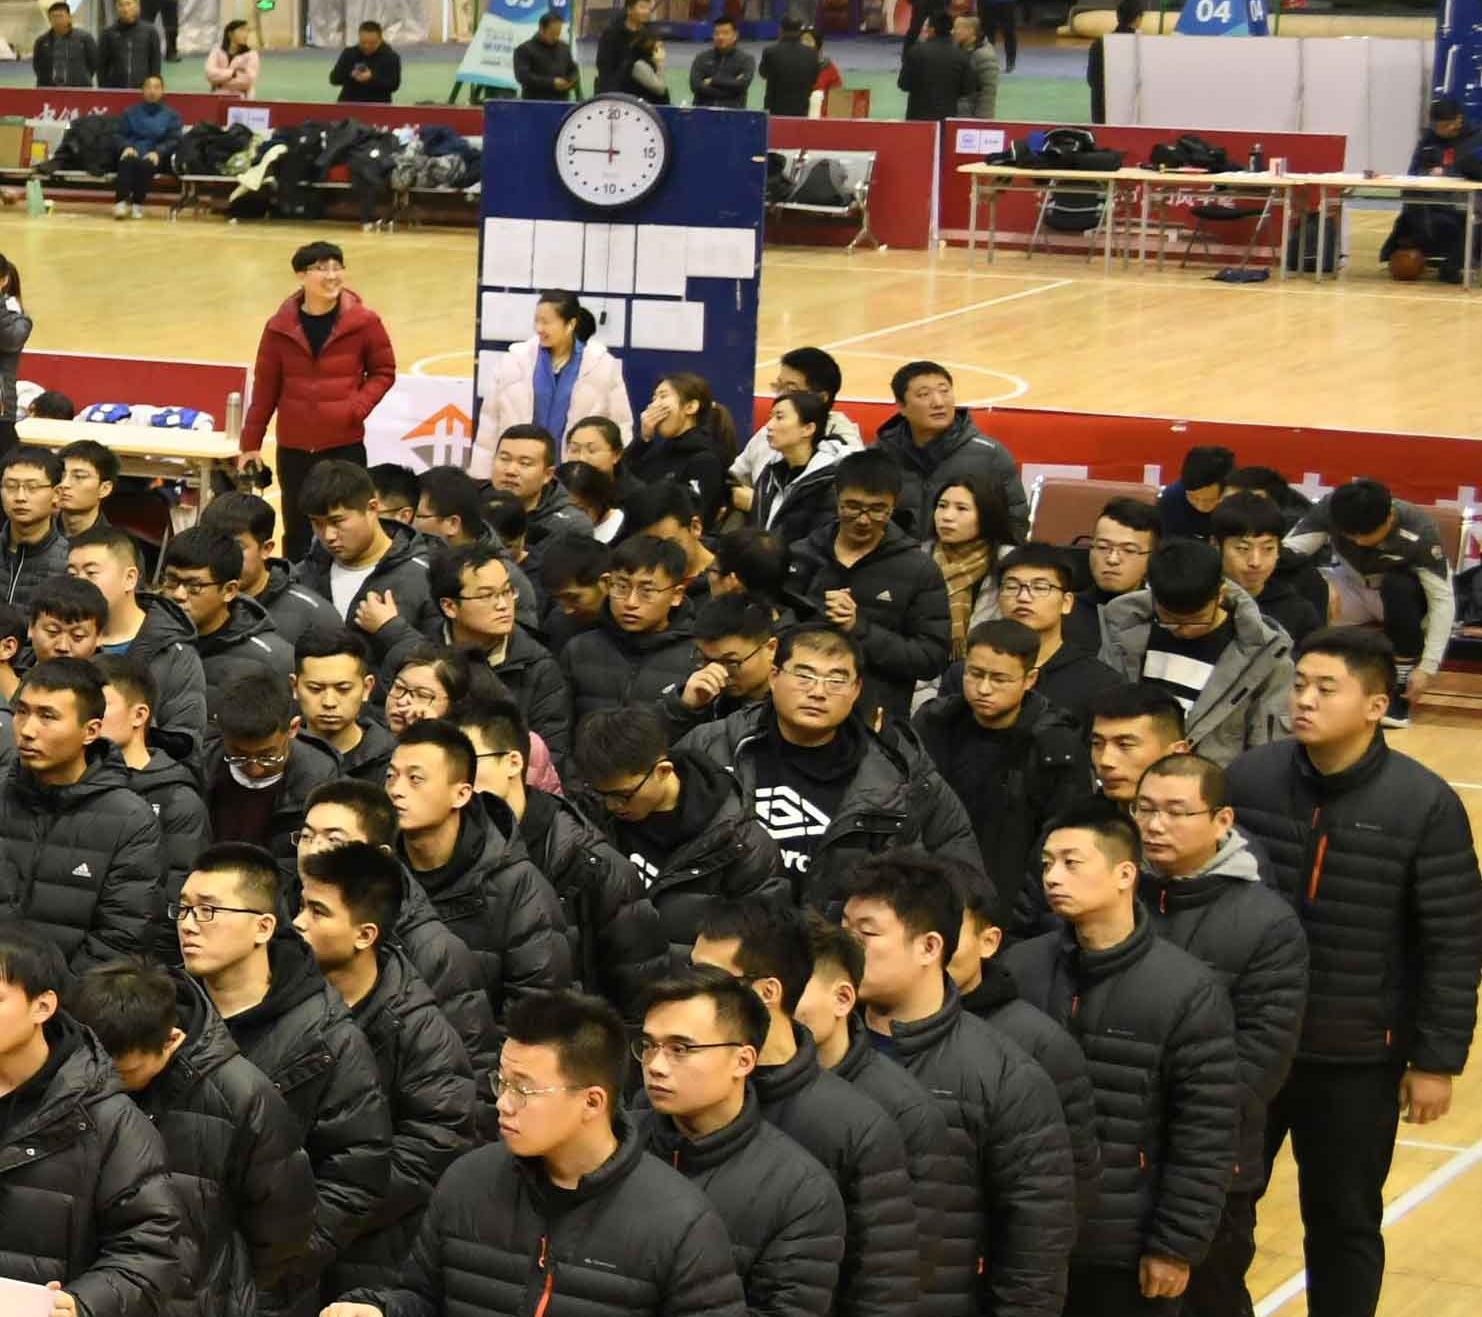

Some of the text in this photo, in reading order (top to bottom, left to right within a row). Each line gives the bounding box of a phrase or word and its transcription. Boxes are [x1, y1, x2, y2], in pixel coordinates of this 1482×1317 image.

[1250, 0, 1264, 22] 04
[607, 108, 621, 121] 20
[568, 144, 576, 157] 5
[643, 146, 657, 160] 15
[603, 184, 616, 195] 10
